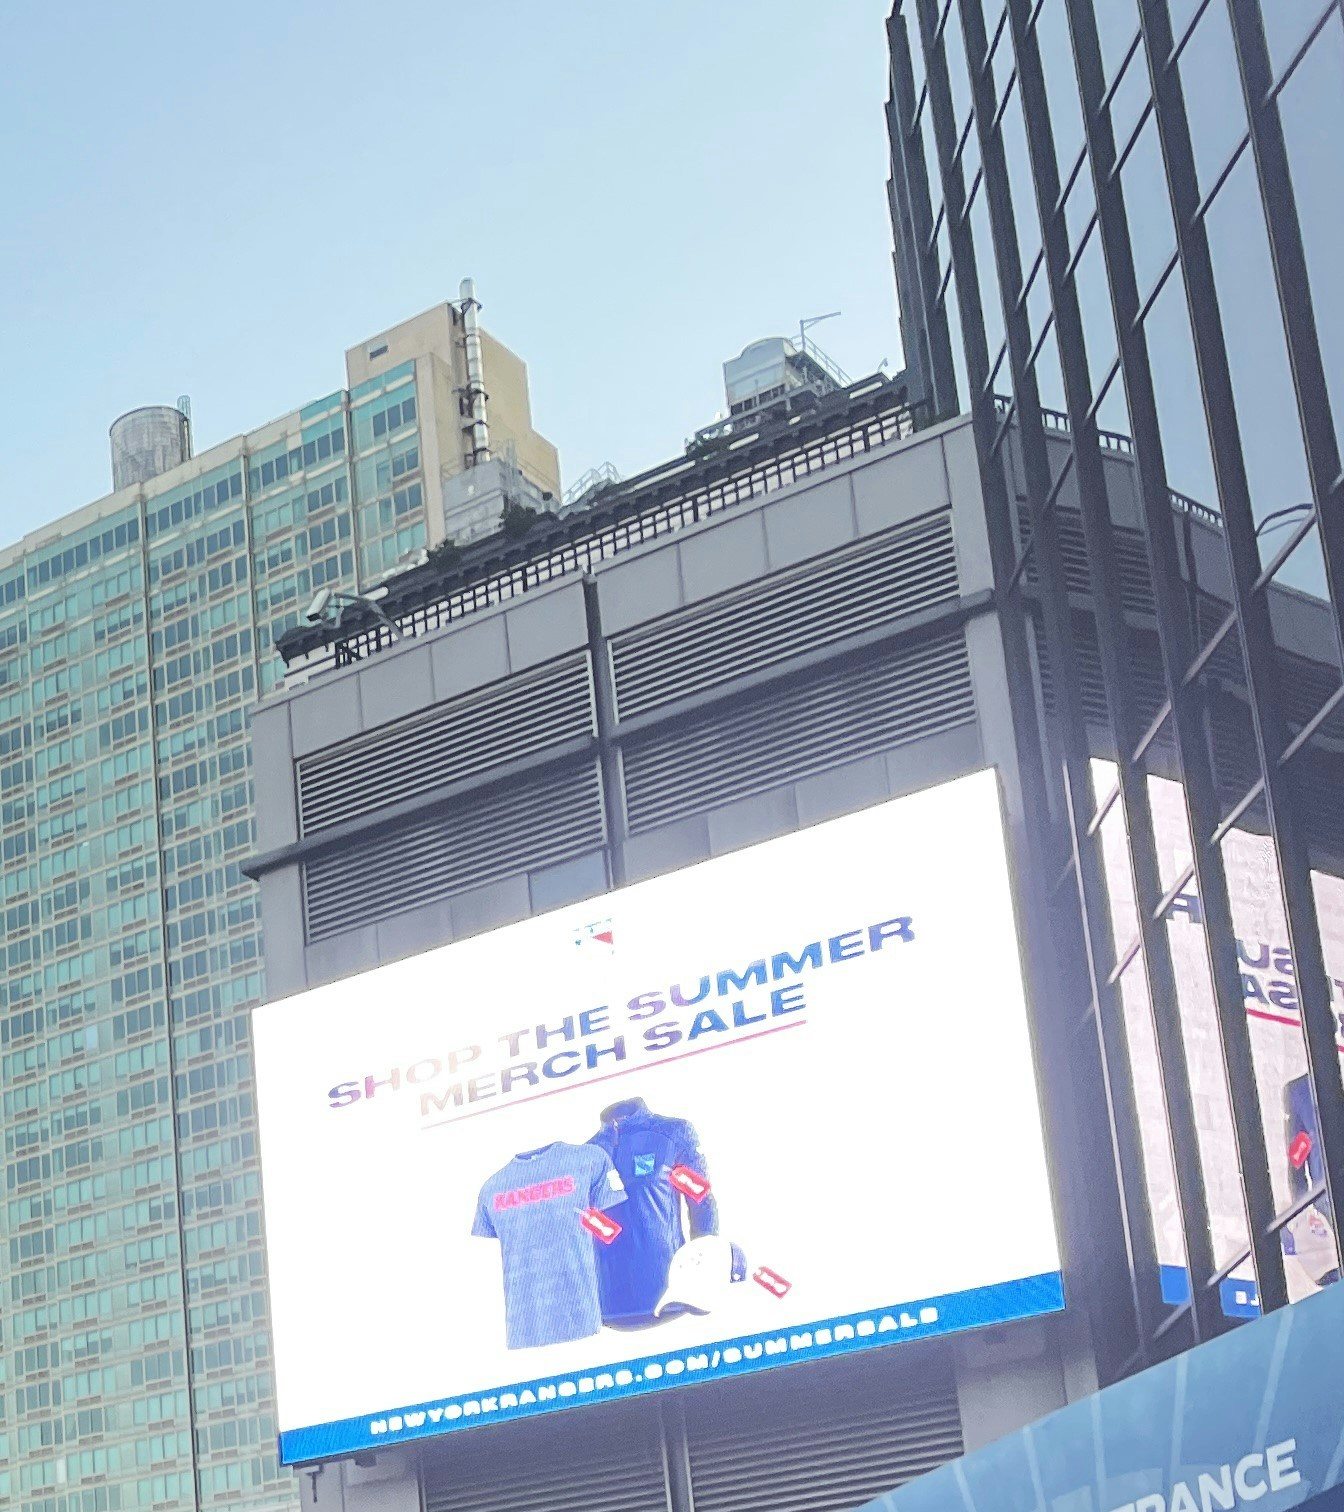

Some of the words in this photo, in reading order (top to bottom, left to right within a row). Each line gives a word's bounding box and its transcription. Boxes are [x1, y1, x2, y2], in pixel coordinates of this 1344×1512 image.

[326, 1043, 483, 1110] SHOP
[498, 1005, 612, 1058] THE
[626, 915, 916, 1022] SUMMER
[419, 1035, 627, 1116] MERCH
[643, 982, 807, 1052] SALE
